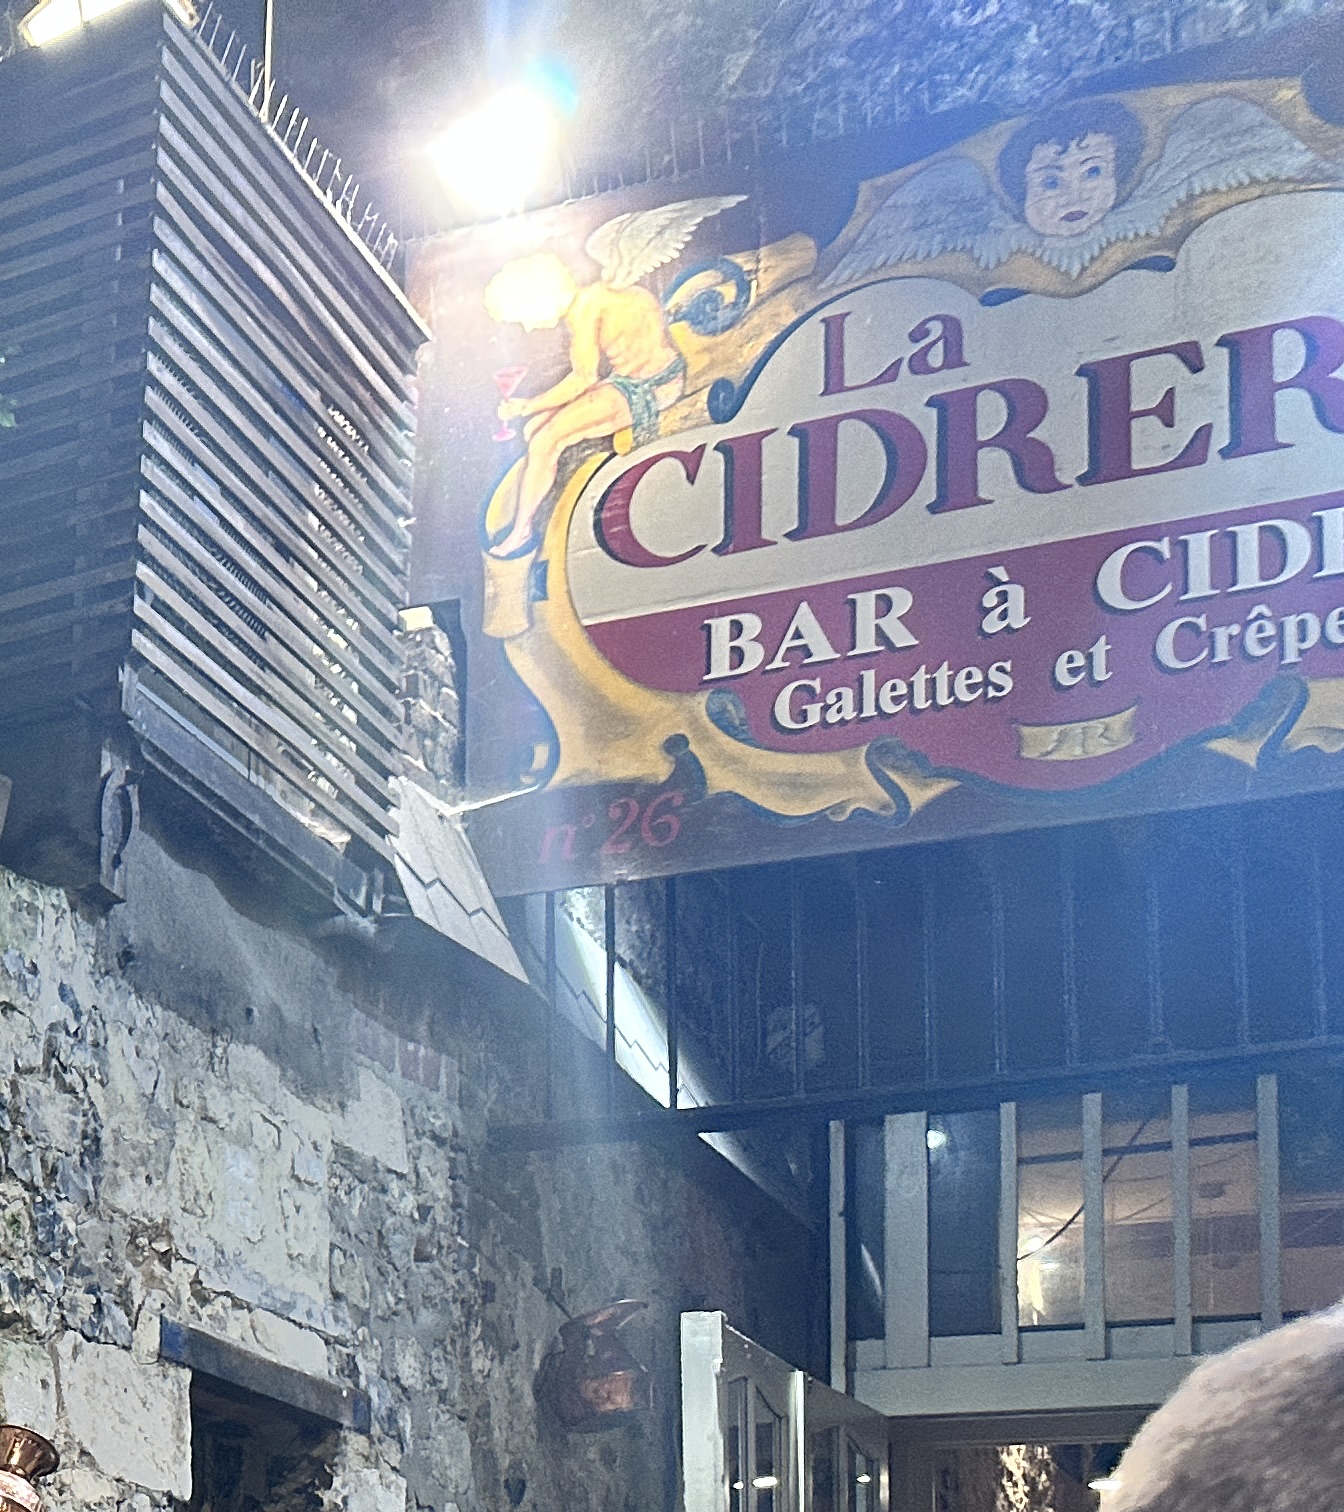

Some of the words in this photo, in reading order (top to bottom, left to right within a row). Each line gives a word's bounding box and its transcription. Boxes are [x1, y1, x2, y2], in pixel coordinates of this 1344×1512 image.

[820, 312, 970, 397] La
[703, 586, 919, 681] BAR
[981, 566, 1031, 634] à
[774, 659, 1013, 730] Galettes
[1055, 635, 1112, 686] et
